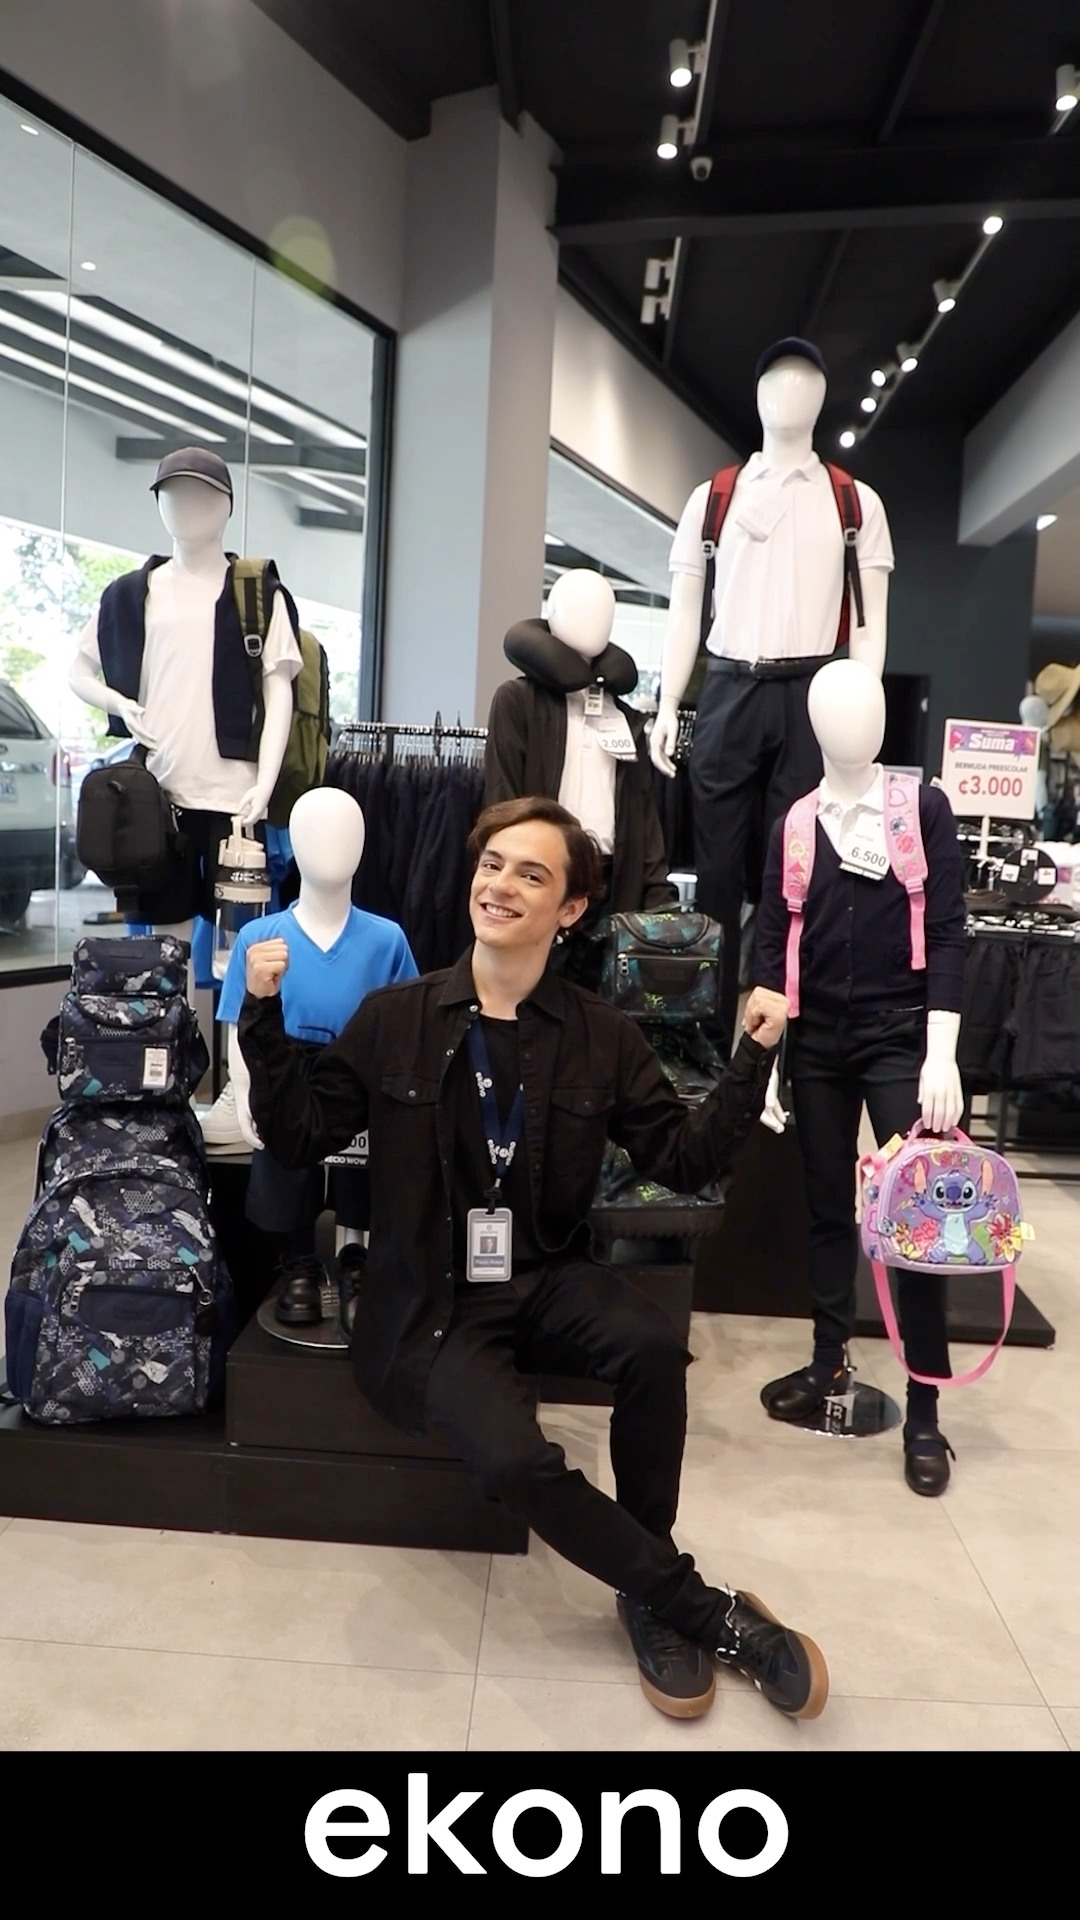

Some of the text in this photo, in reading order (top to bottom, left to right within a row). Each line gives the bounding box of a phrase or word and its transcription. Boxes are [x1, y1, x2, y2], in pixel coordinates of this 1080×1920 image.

[603, 739, 631, 748] 2.000
[968, 732, 1015, 751] Suma
[955, 761, 1028, 773] BERMUDA PREESCOLAR
[851, 846, 887, 867] 6.500
[346, 1156, 368, 1166] WOW
